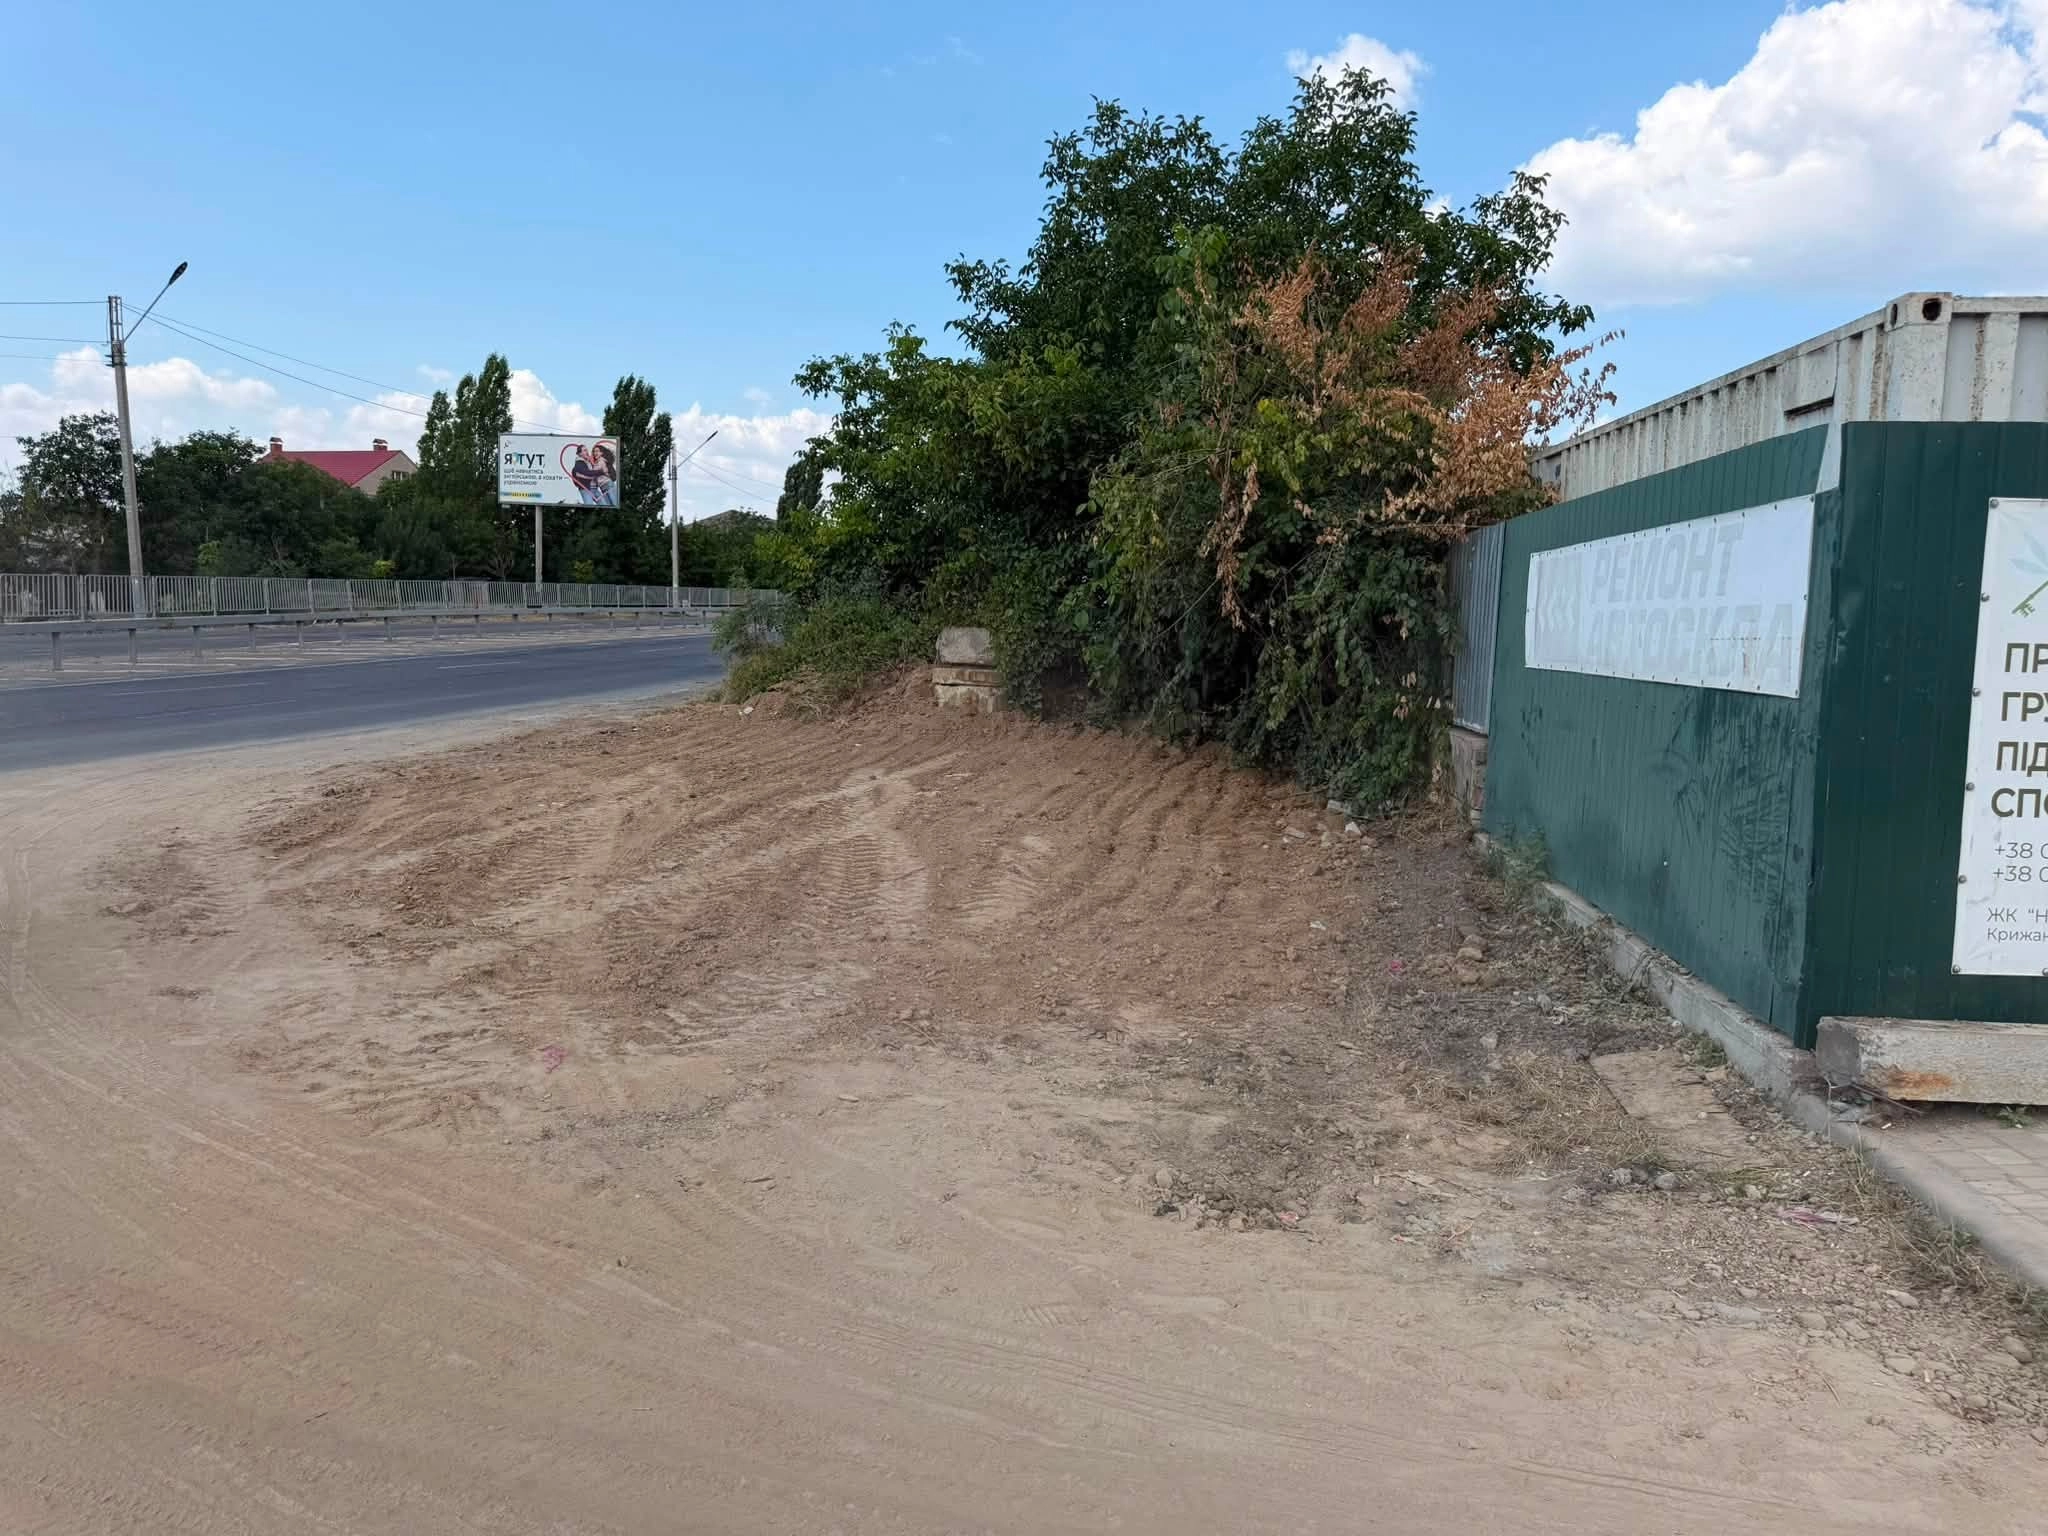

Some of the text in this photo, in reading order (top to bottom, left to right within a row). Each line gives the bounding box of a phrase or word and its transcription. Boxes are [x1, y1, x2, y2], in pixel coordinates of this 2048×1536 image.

[1591, 522, 1744, 604] РЕМОНТ
[2001, 691, 2048, 722] ГР
[1996, 741, 2048, 777] ПІД
[1991, 788, 2048, 818] СП
[1994, 842, 2033, 859] +38
[1992, 866, 2032, 882] +38
[1986, 907, 2018, 923] ЖК
